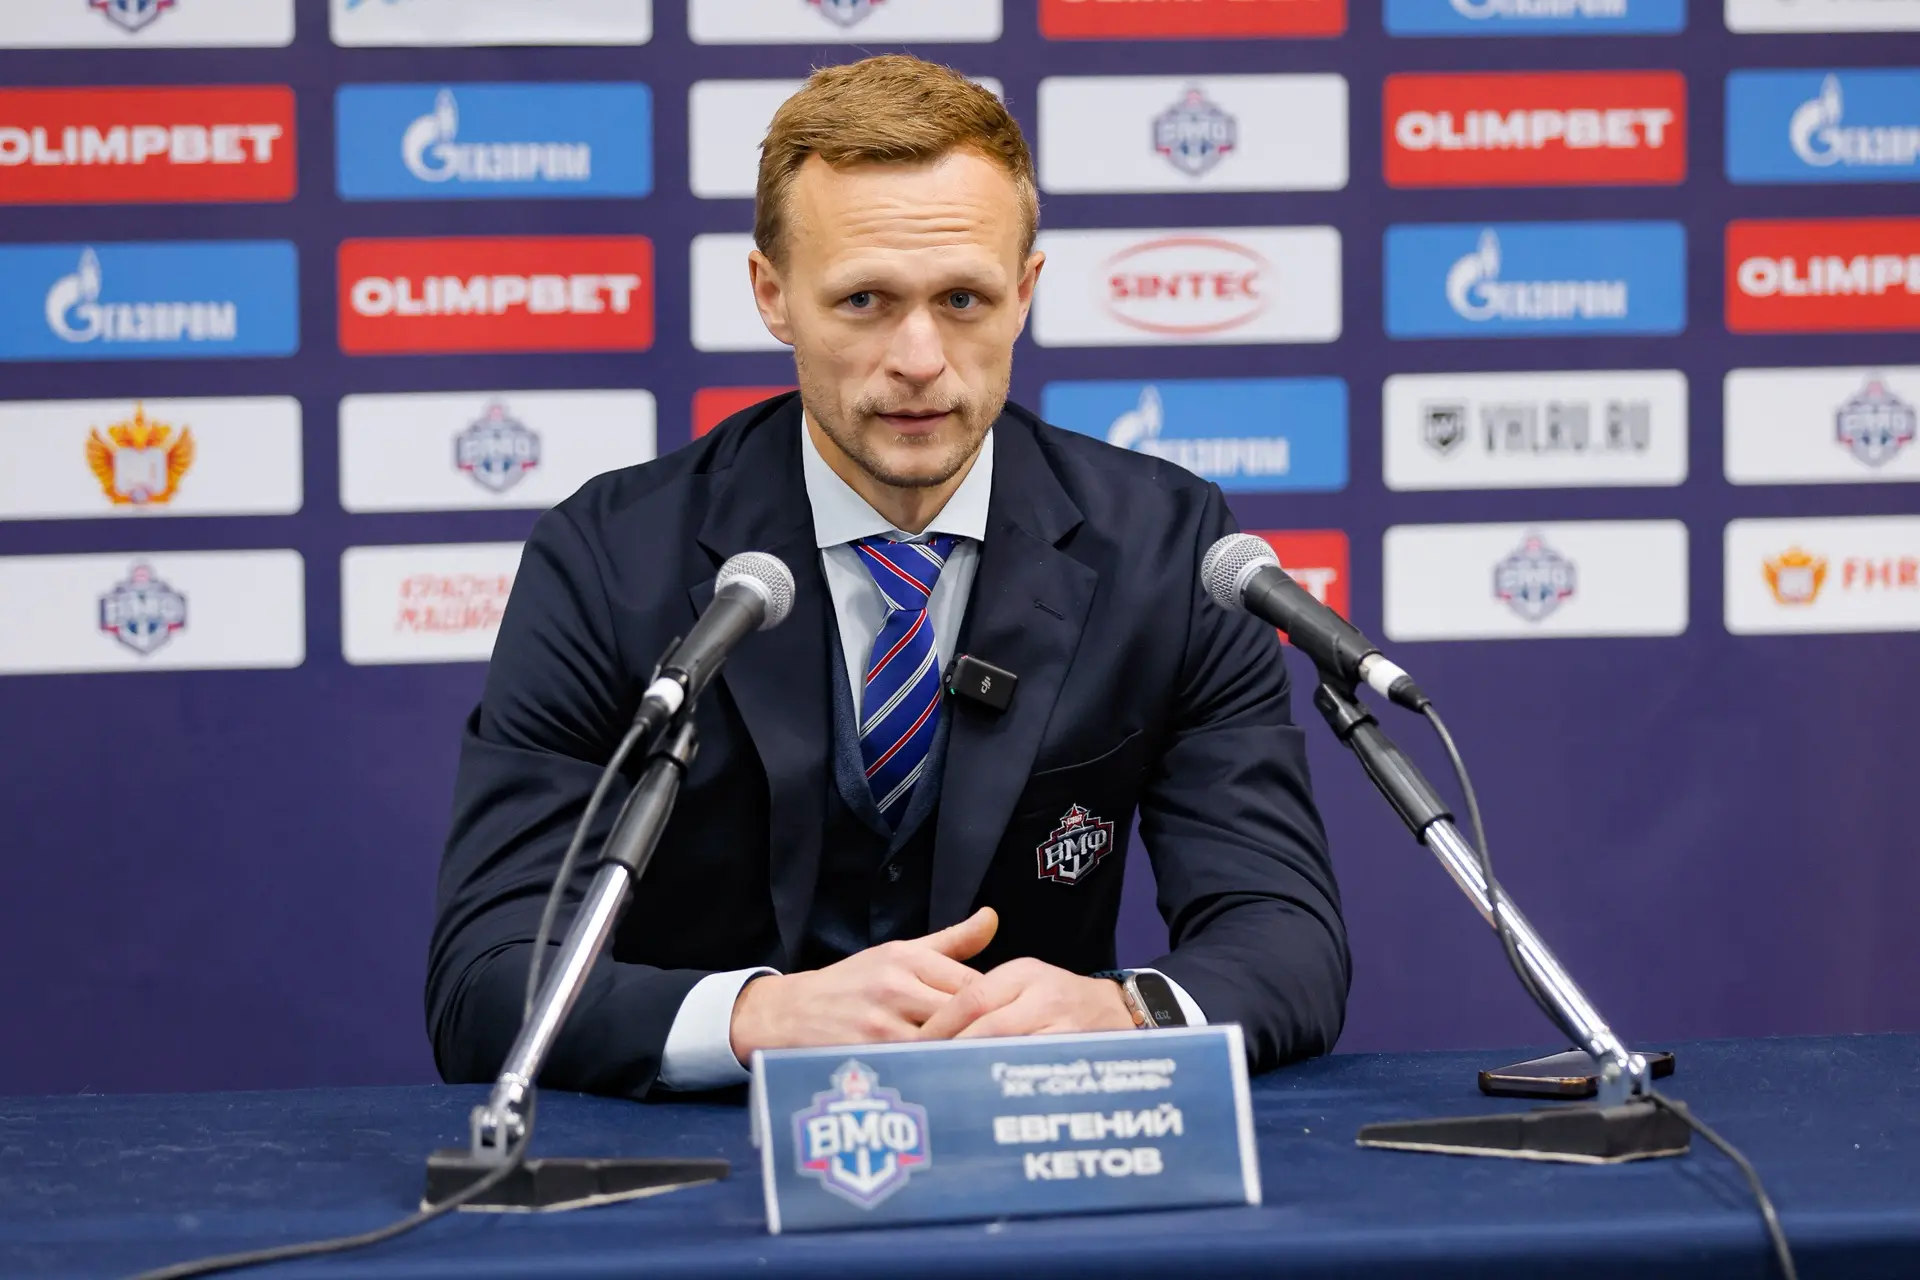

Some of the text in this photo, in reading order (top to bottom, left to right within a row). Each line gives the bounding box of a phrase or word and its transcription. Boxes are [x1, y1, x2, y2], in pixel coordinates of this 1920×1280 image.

[0, 125, 283, 166] OLIMPBET
[1395, 108, 1673, 150] OLIMPBET
[352, 274, 642, 317] OLIMPBET
[1108, 270, 1261, 301] SINTEC
[1044, 829, 1107, 870] ВМФ
[808, 1111, 918, 1159] ВМФ
[993, 1103, 1184, 1145] ЕВГЕНИЙ
[1023, 1147, 1164, 1181] КЕТОВ
